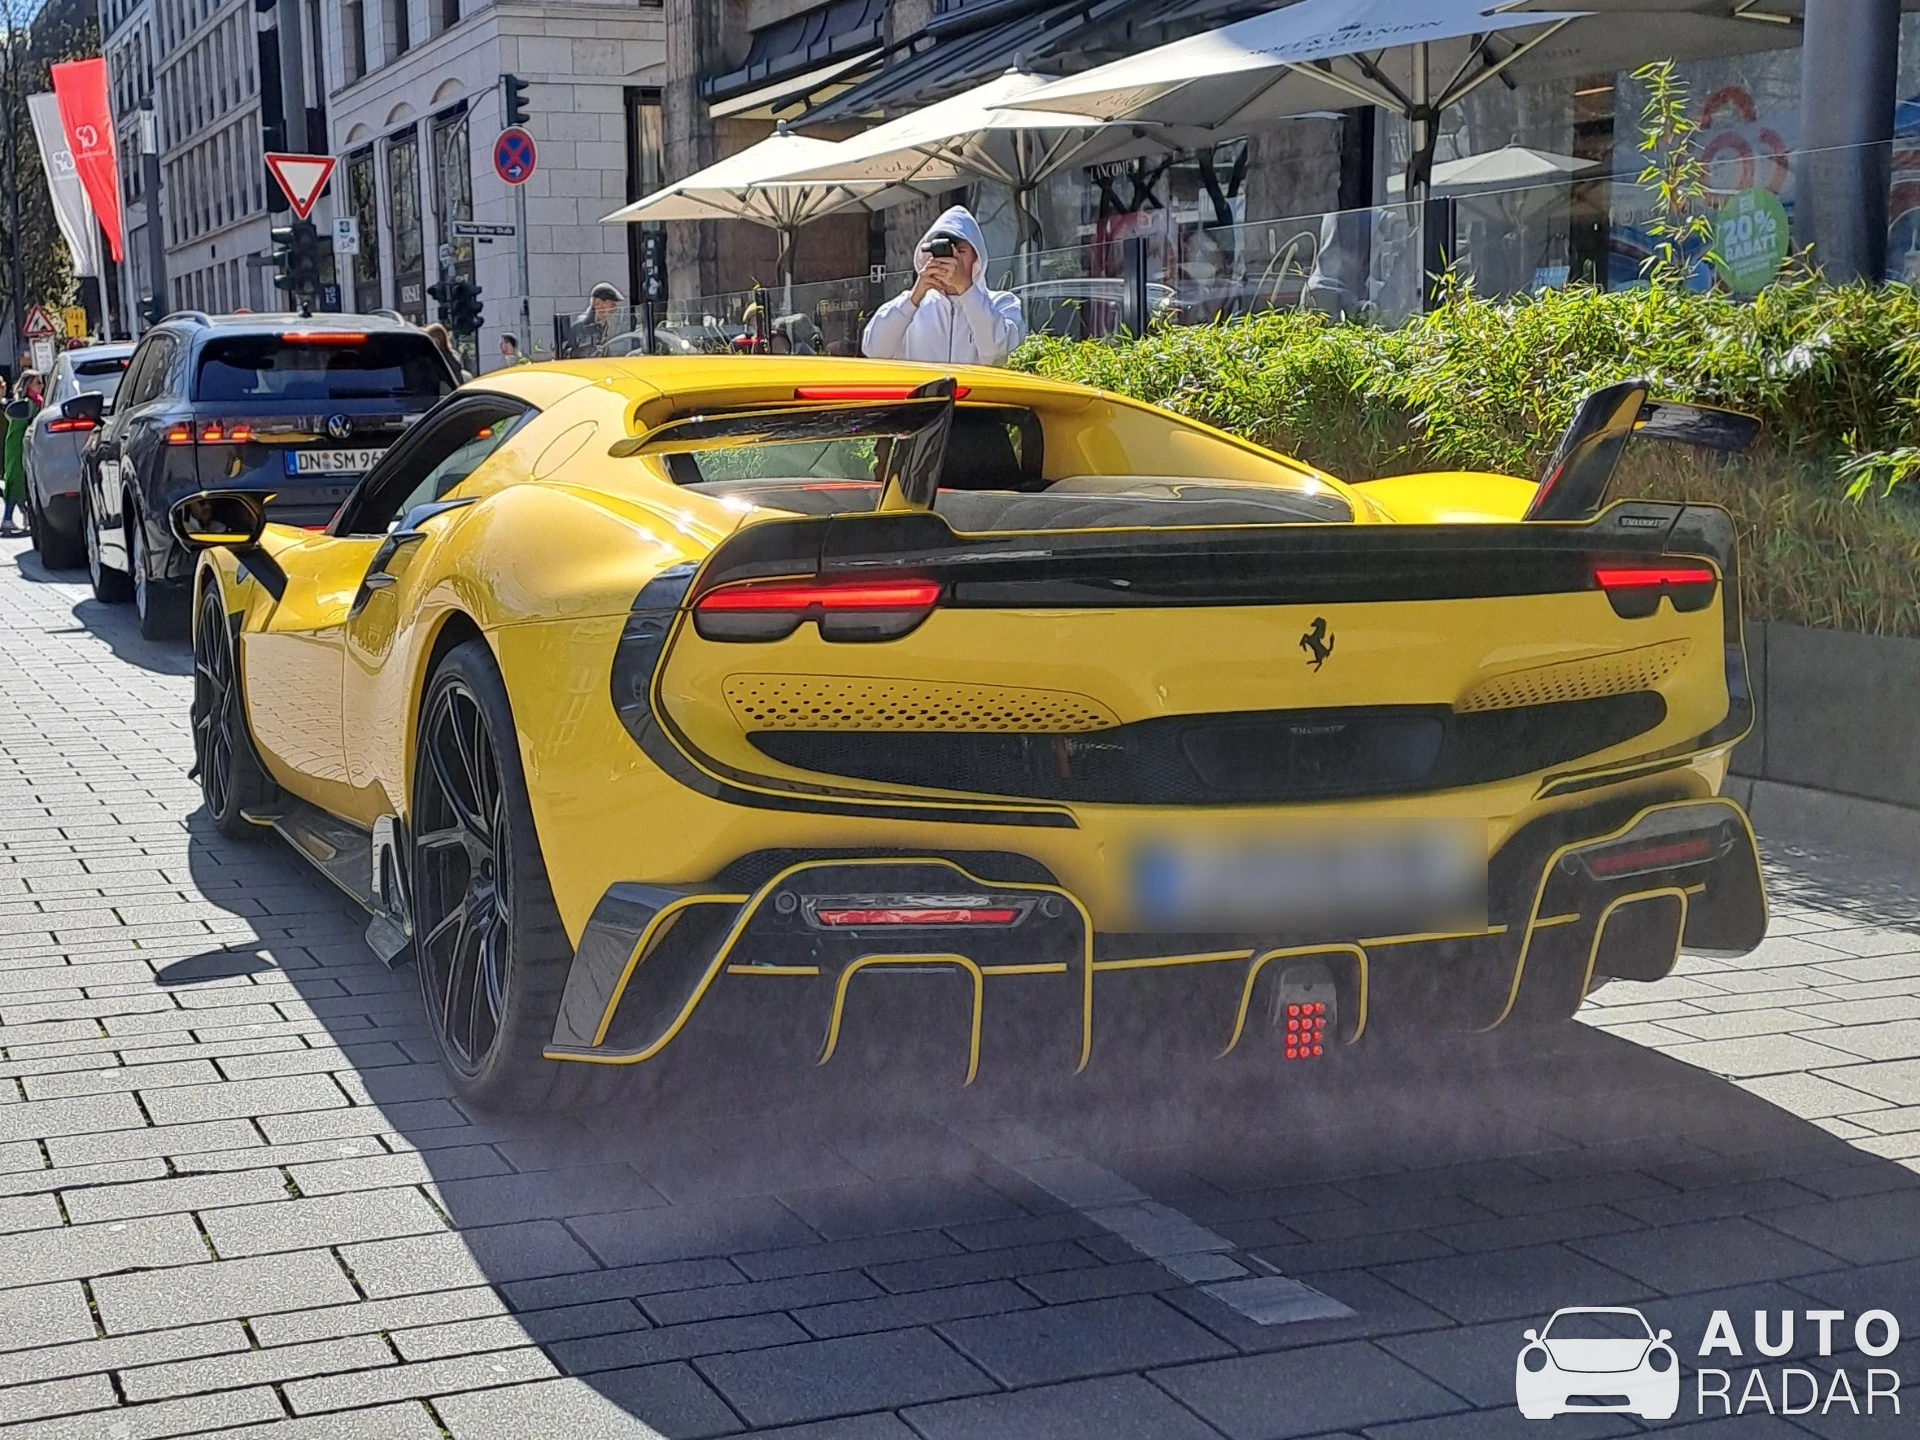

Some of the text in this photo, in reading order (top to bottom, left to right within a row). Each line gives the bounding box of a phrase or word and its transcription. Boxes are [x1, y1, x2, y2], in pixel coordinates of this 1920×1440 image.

[1329, 20, 1444, 42] CHANDON
[1725, 234, 1776, 262] RABATT
[298, 450, 387, 470] DN SM 96
